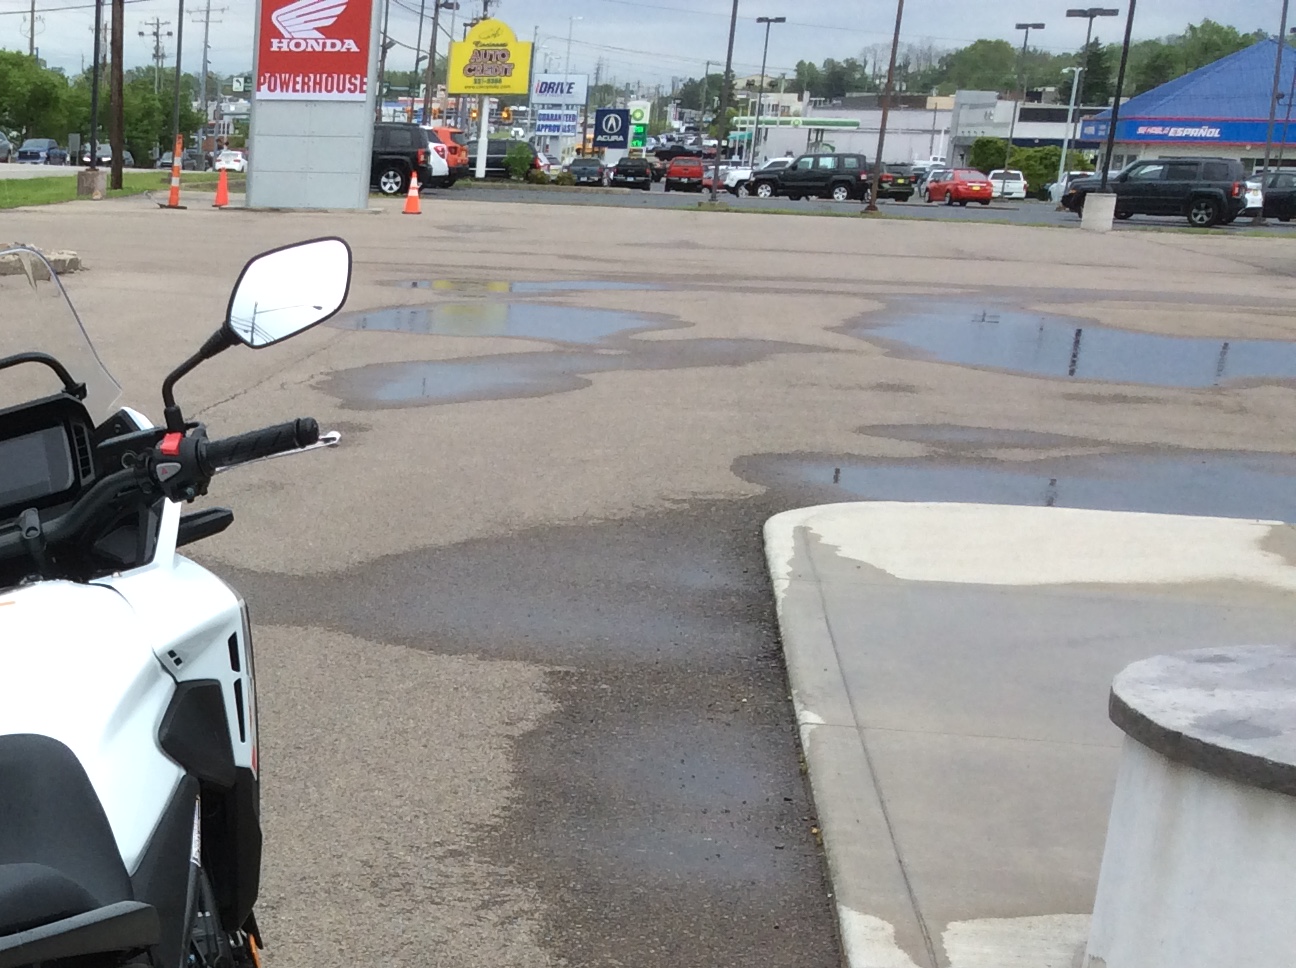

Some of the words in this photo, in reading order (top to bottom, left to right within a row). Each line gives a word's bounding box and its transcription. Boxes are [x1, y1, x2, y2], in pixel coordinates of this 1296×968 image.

[270, 38, 360, 52] HONDA
[469, 49, 511, 63] AUTO
[463, 63, 515, 77] CREDIT
[256, 73, 367, 94] POWERHOUSE
[535, 80, 575, 94] iDRIVE
[1168, 126, 1221, 137] ESPAÑOL
